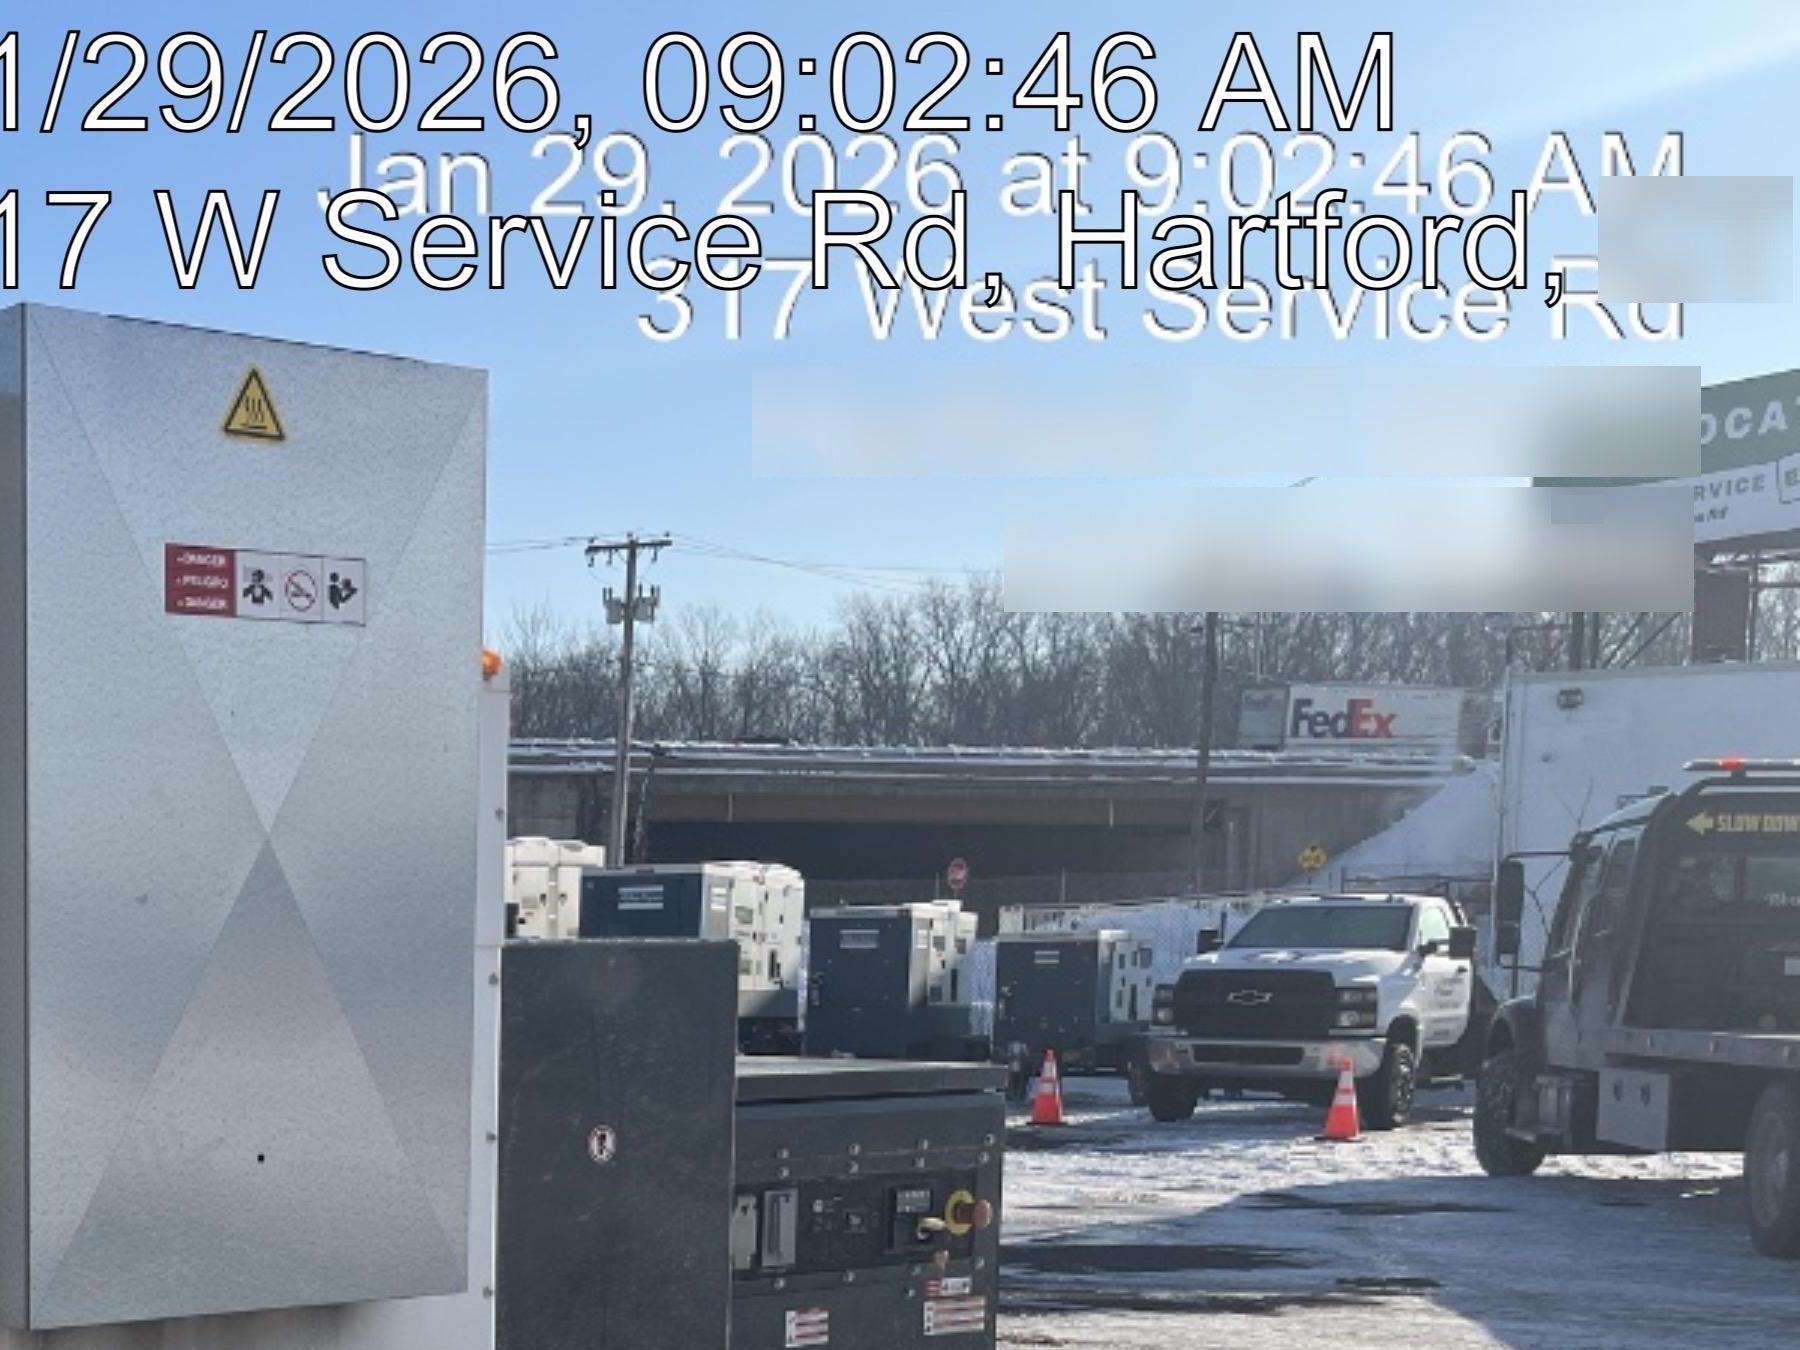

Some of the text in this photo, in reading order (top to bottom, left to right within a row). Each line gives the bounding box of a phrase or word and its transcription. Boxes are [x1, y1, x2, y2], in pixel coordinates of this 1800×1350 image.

[1291, 698, 1397, 739] FedEx
[1717, 815, 1800, 833] SLOW DOW
